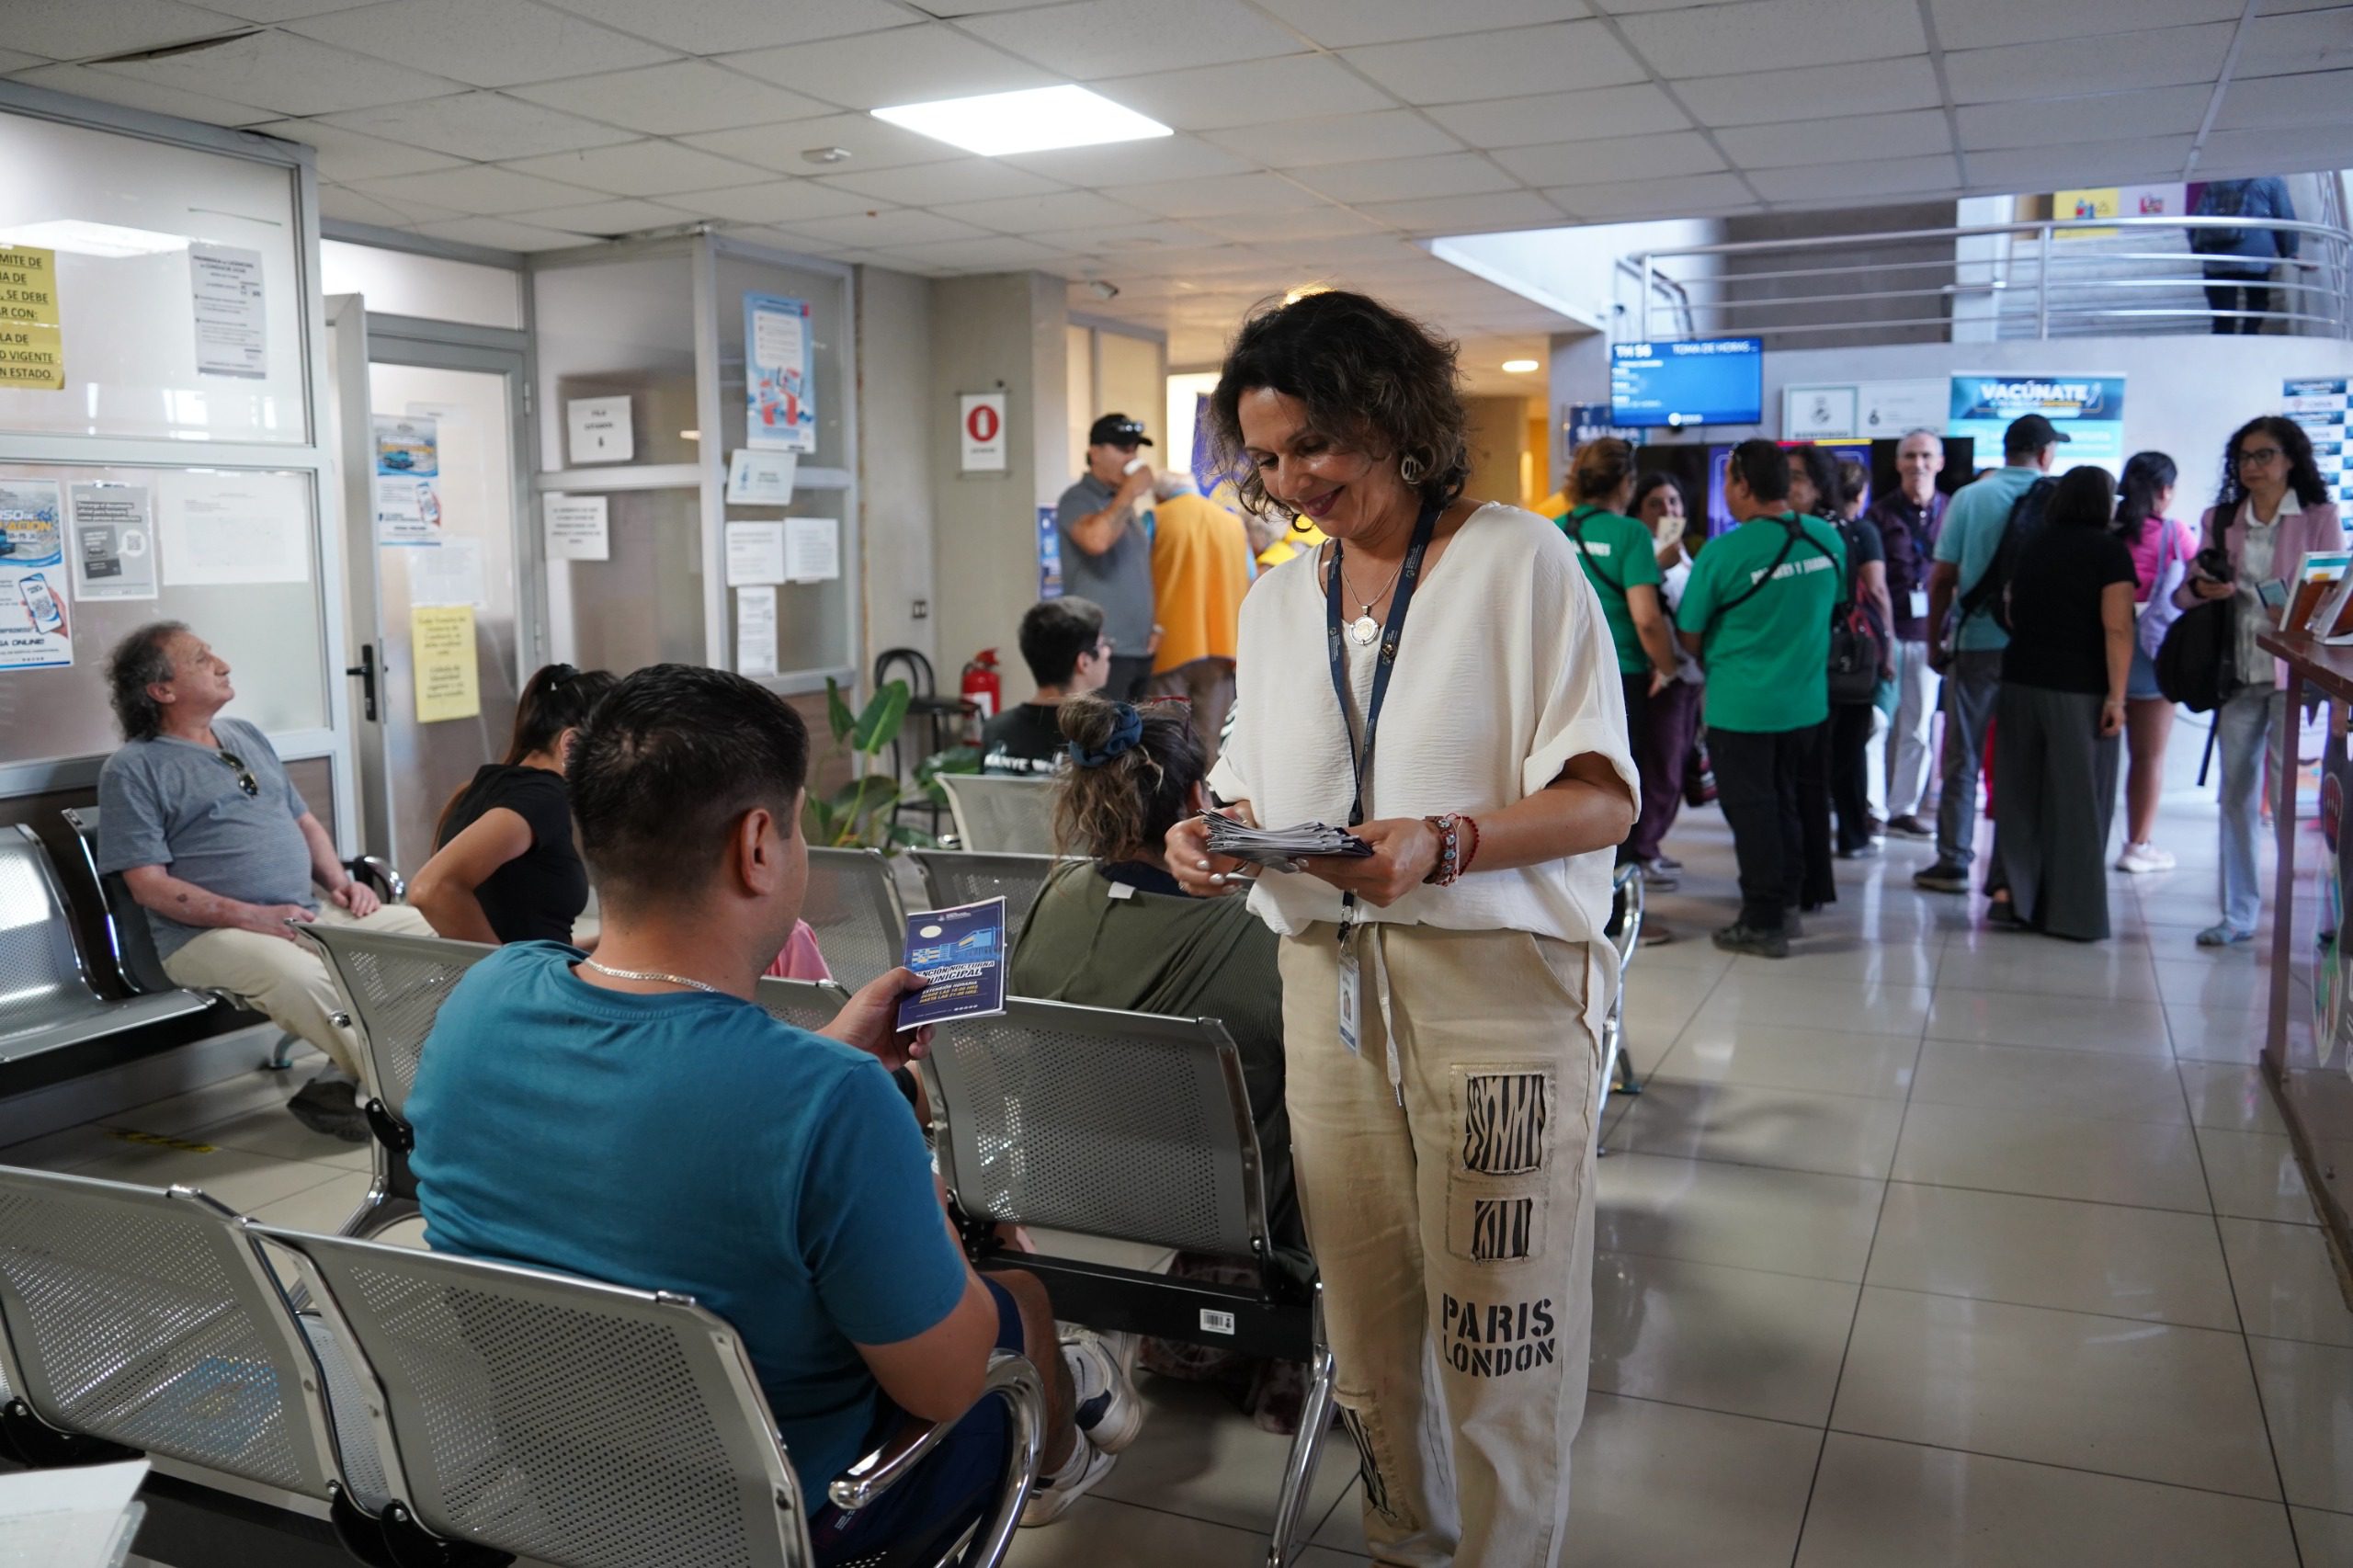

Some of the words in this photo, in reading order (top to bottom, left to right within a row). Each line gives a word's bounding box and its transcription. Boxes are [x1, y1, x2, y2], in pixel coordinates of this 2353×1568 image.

[28, 257, 42, 267] DE
[13, 273, 27, 283] DE
[21, 291, 49, 302] DEBE
[15, 334, 28, 344] DE
[9, 351, 53, 362] VIGENTE
[10, 368, 53, 380] ESTADO.
[1980, 380, 2088, 401] VACÚNATE
[949, 960, 995, 971] NOCTURNA
[1442, 1293, 1555, 1344] PARIS
[1443, 1337, 1555, 1378] LONDON
